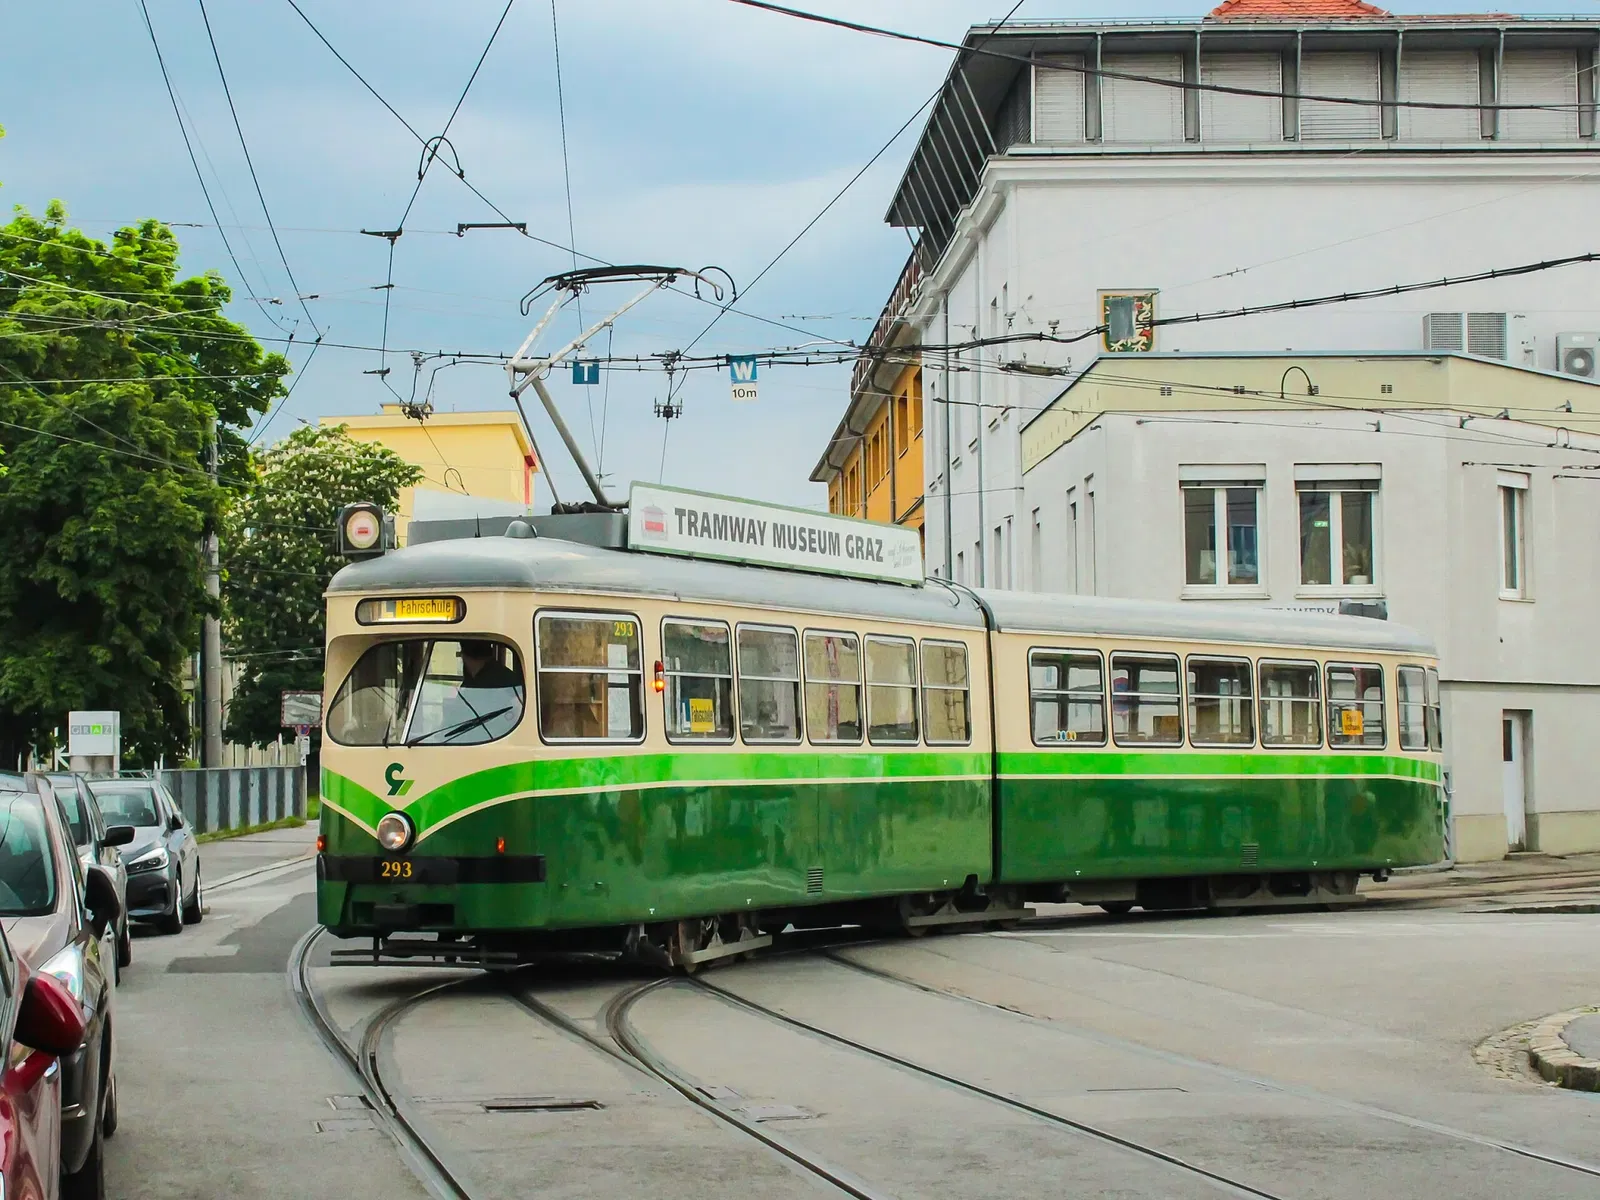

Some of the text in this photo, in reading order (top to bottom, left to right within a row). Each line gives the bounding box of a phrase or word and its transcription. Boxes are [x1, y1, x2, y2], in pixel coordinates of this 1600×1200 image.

[579, 363, 593, 381] T
[733, 361, 753, 380] W
[732, 388, 757, 398] 10m
[674, 507, 884, 563] TRAMWAY MUSEUM GRAZ
[401, 601, 451, 614] Fahrschule
[614, 621, 634, 636] 293
[71, 725, 112, 735] GRAZ
[381, 861, 413, 878] 293
